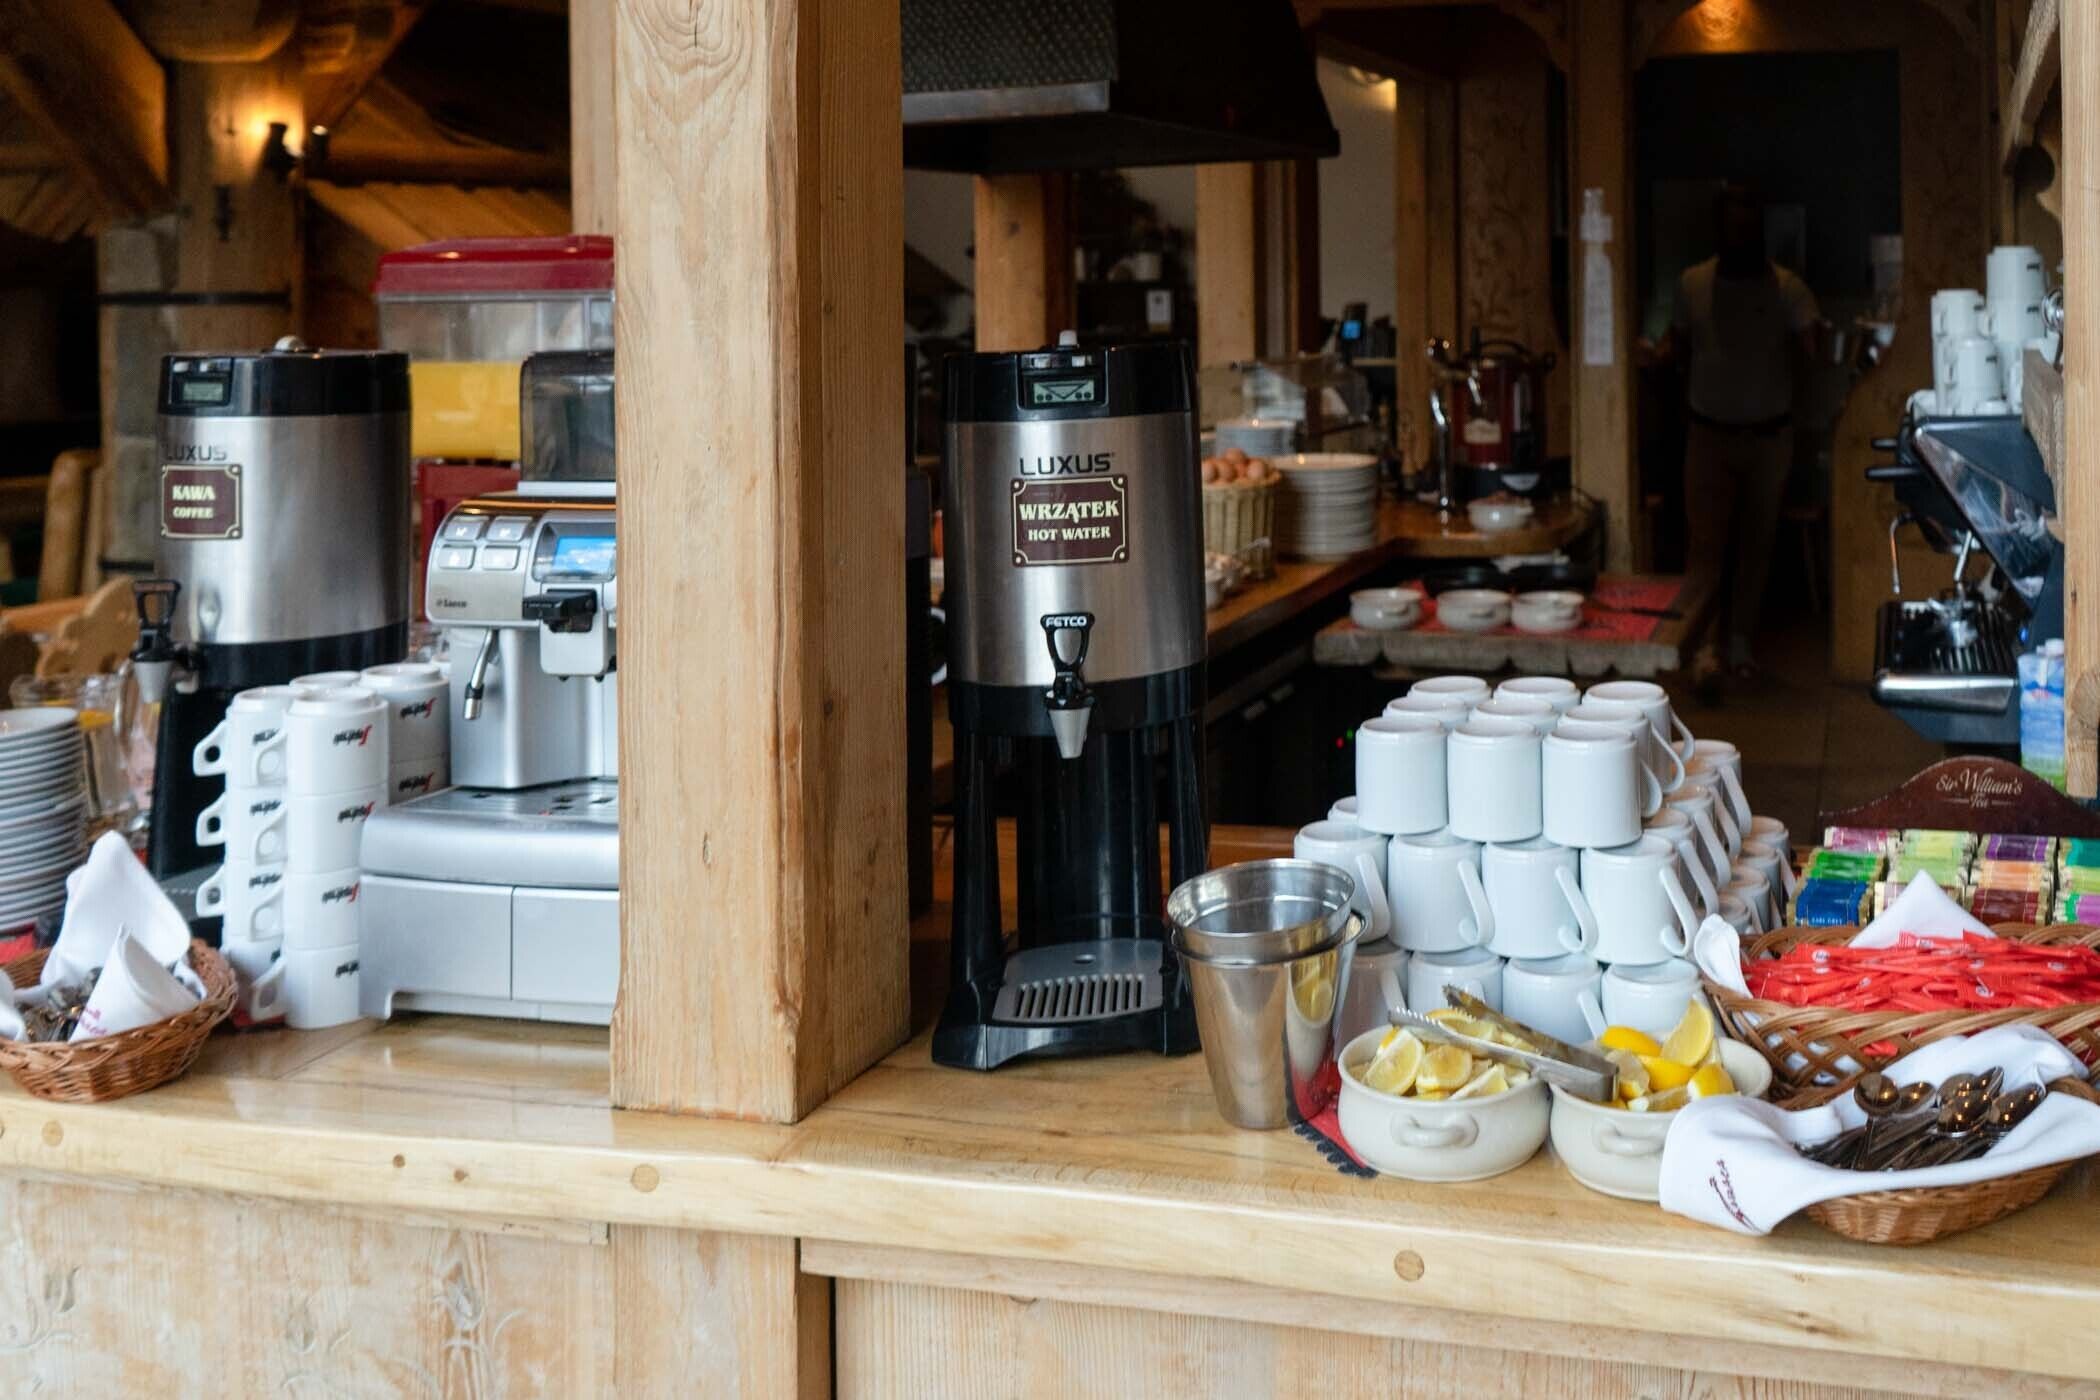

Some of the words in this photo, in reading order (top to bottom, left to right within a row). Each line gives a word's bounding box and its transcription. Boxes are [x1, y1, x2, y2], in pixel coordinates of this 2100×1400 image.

[163, 444, 227, 461] LUXUS
[1019, 453, 1111, 476] LUXUS
[172, 485, 216, 501] KAWA
[172, 506, 214, 519] COFFEE
[1019, 500, 1120, 524] WRZĄTEK
[1028, 528, 1058, 541] HOT
[1062, 526, 1111, 541] WATER
[1045, 615, 1088, 628] FETCO
[1935, 774, 1959, 792] Sir
[1960, 767, 2023, 795] William's
